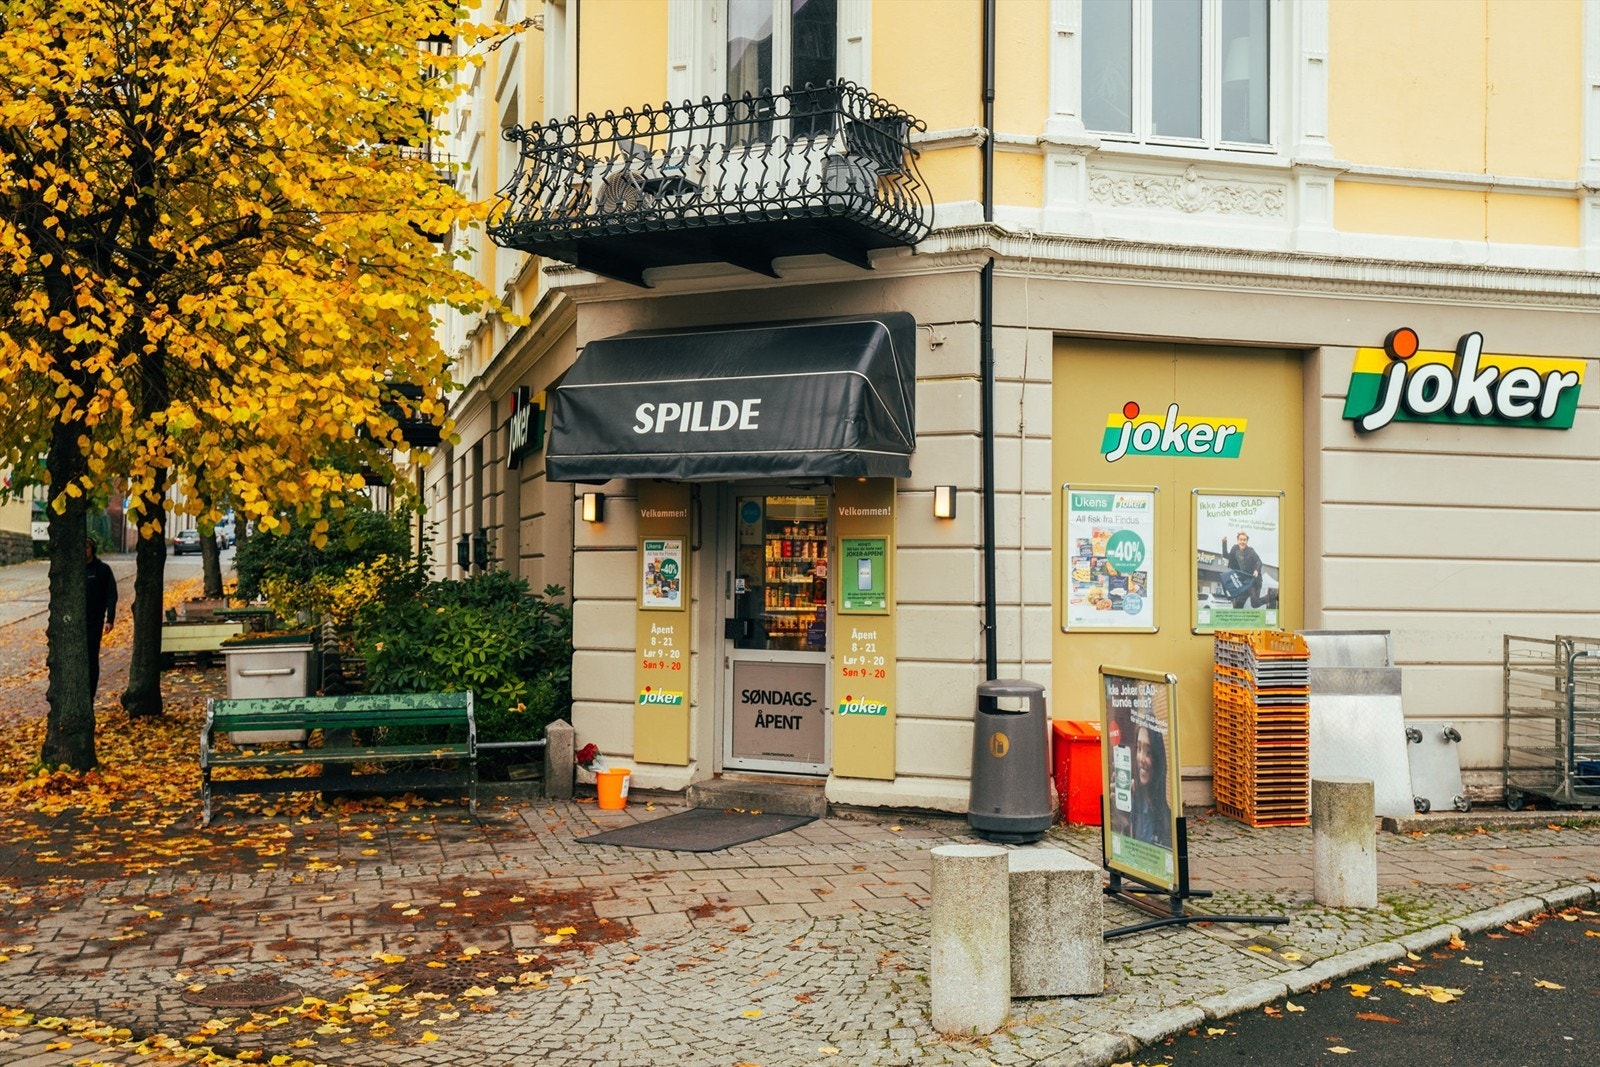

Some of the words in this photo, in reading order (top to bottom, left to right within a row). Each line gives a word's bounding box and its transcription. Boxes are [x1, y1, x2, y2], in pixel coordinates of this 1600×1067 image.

[1354, 327, 1580, 433] joker
[633, 399, 761, 434] SPILDE
[1105, 401, 1237, 463] joker
[1075, 496, 1107, 508] Ukens
[1199, 501, 1216, 510] Ikke
[1218, 500, 1239, 509] Joker
[1241, 498, 1265, 507] GLAD-
[641, 509, 687, 518] Velkommen!
[838, 507, 891, 516] Velkommen!
[1207, 509, 1231, 518] kunde
[1076, 514, 1086, 523] All
[1088, 514, 1101, 523] fisk
[1103, 515, 1113, 524] fra
[1115, 515, 1140, 525] Findus
[1107, 541, 1142, 562] -40%
[651, 622, 674, 635] Åpent
[851, 628, 877, 640] Åpent
[651, 636, 656, 646] 8
[663, 637, 673, 646] 21
[852, 642, 858, 652] 8
[865, 643, 876, 652] 21
[643, 649, 656, 658] Lør
[658, 649, 663, 658] 9
[670, 650, 680, 658] 20
[643, 660, 657, 669] Søn
[659, 661, 664, 669] 9
[671, 662, 681, 670] 20
[843, 656, 857, 665] Lør
[859, 655, 865, 665] 9
[873, 656, 884, 666] 20
[842, 667, 858, 677] Søn
[861, 668, 866, 677] 9
[874, 669, 885, 678] 20
[640, 685, 680, 705] joker
[1120, 684, 1138, 696] Joker
[741, 689, 817, 706] SØNDAGS-
[1111, 696, 1132, 708] kunde
[841, 695, 885, 716] joker
[754, 709, 803, 730] ÅPENT
